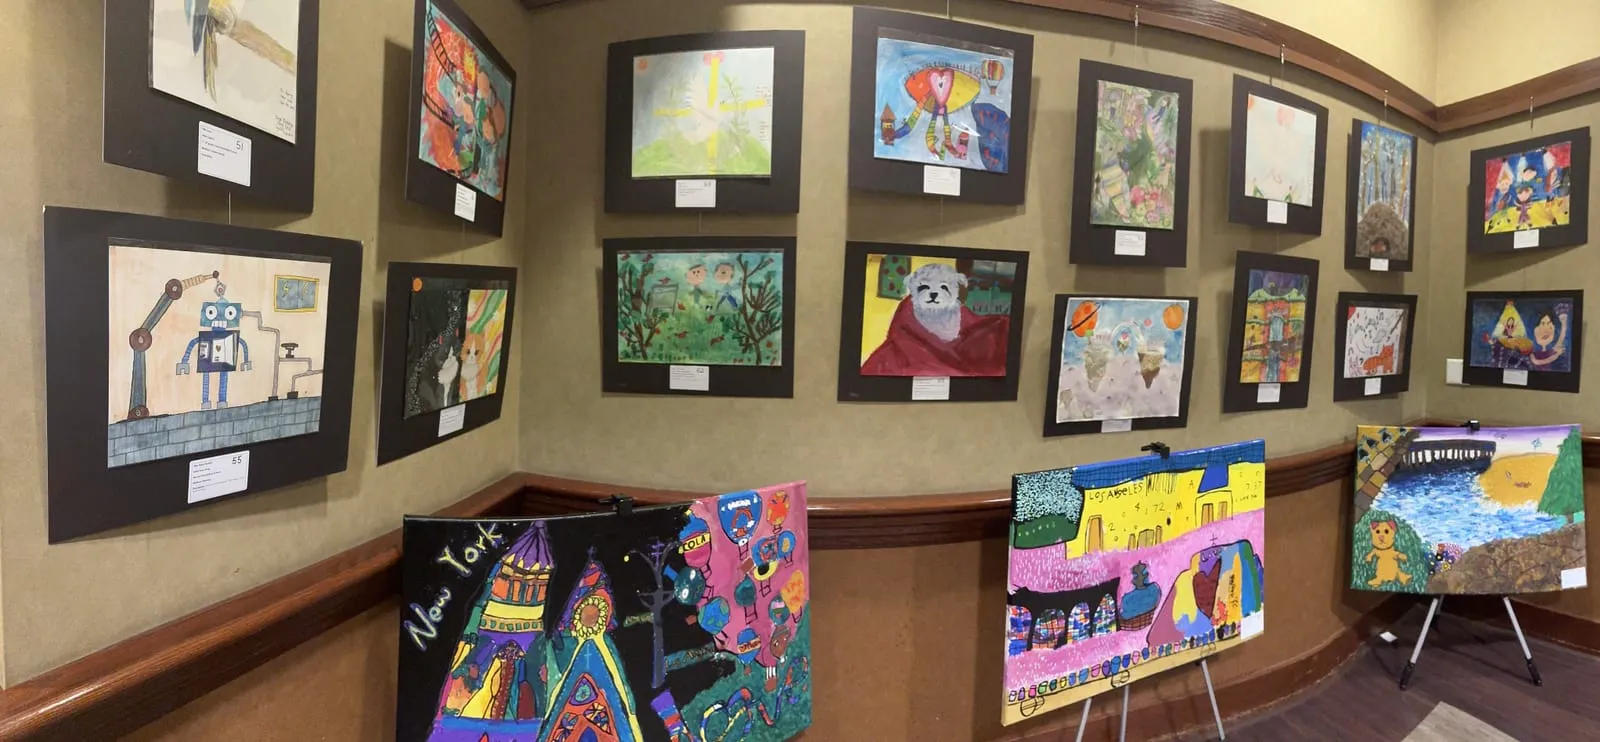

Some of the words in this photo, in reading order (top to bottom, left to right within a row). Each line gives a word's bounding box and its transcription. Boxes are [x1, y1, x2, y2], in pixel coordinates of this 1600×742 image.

[232, 455, 242, 465] 55
[437, 522, 503, 577] York
[683, 535, 706, 551] COLA
